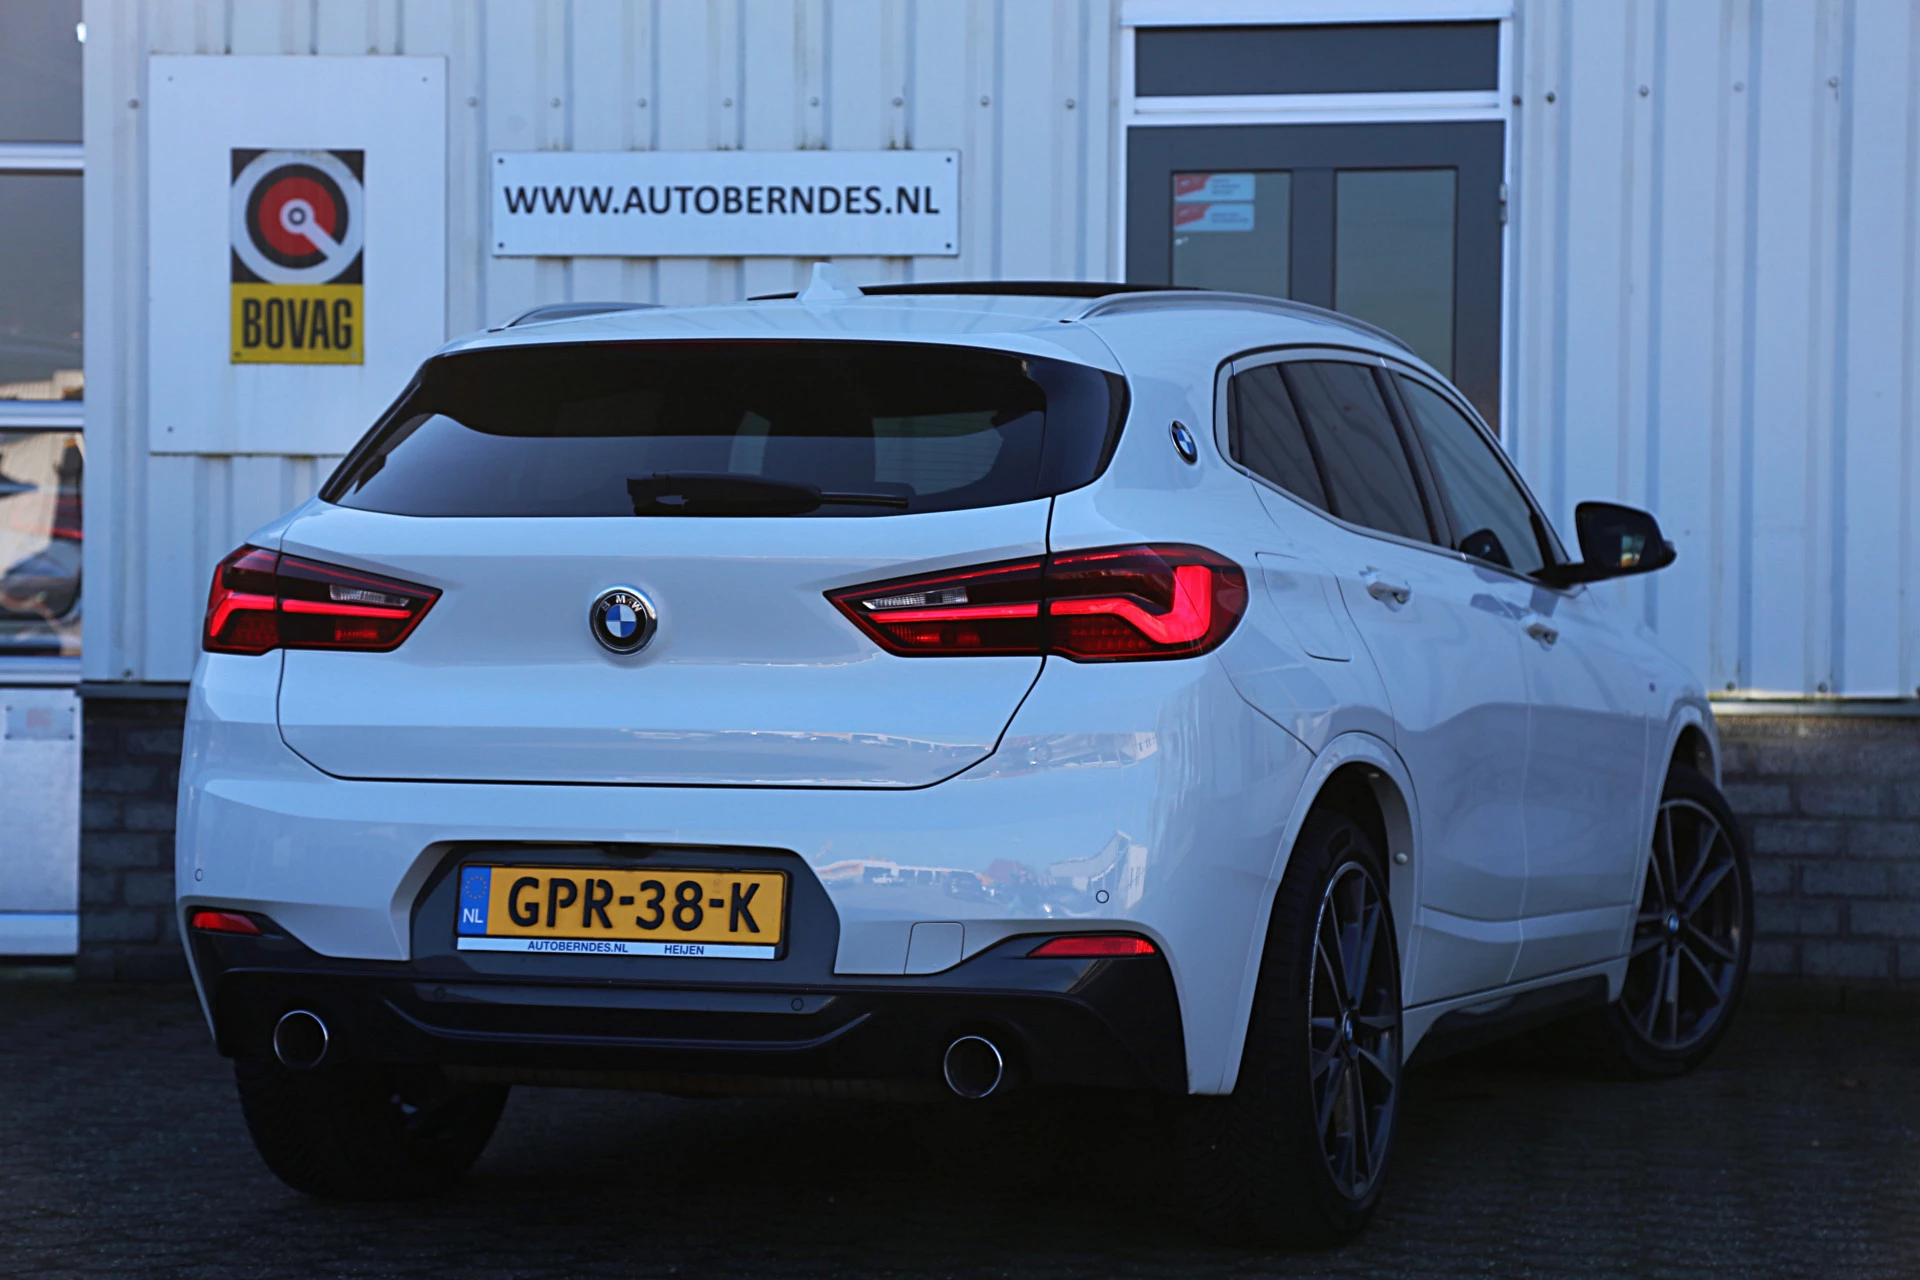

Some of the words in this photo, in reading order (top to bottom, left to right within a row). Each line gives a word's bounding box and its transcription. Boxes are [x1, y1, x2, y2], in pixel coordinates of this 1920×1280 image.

[504, 185, 940, 215] WWW.AUTOBERNDES.NL
[242, 297, 353, 350] BOVAG
[600, 594, 643, 612] BMW
[462, 908, 484, 924] NL
[508, 876, 761, 933] GPR-38-K
[527, 940, 629, 953] AUTOBERNDES.NL
[664, 943, 705, 956] HEIJEN
